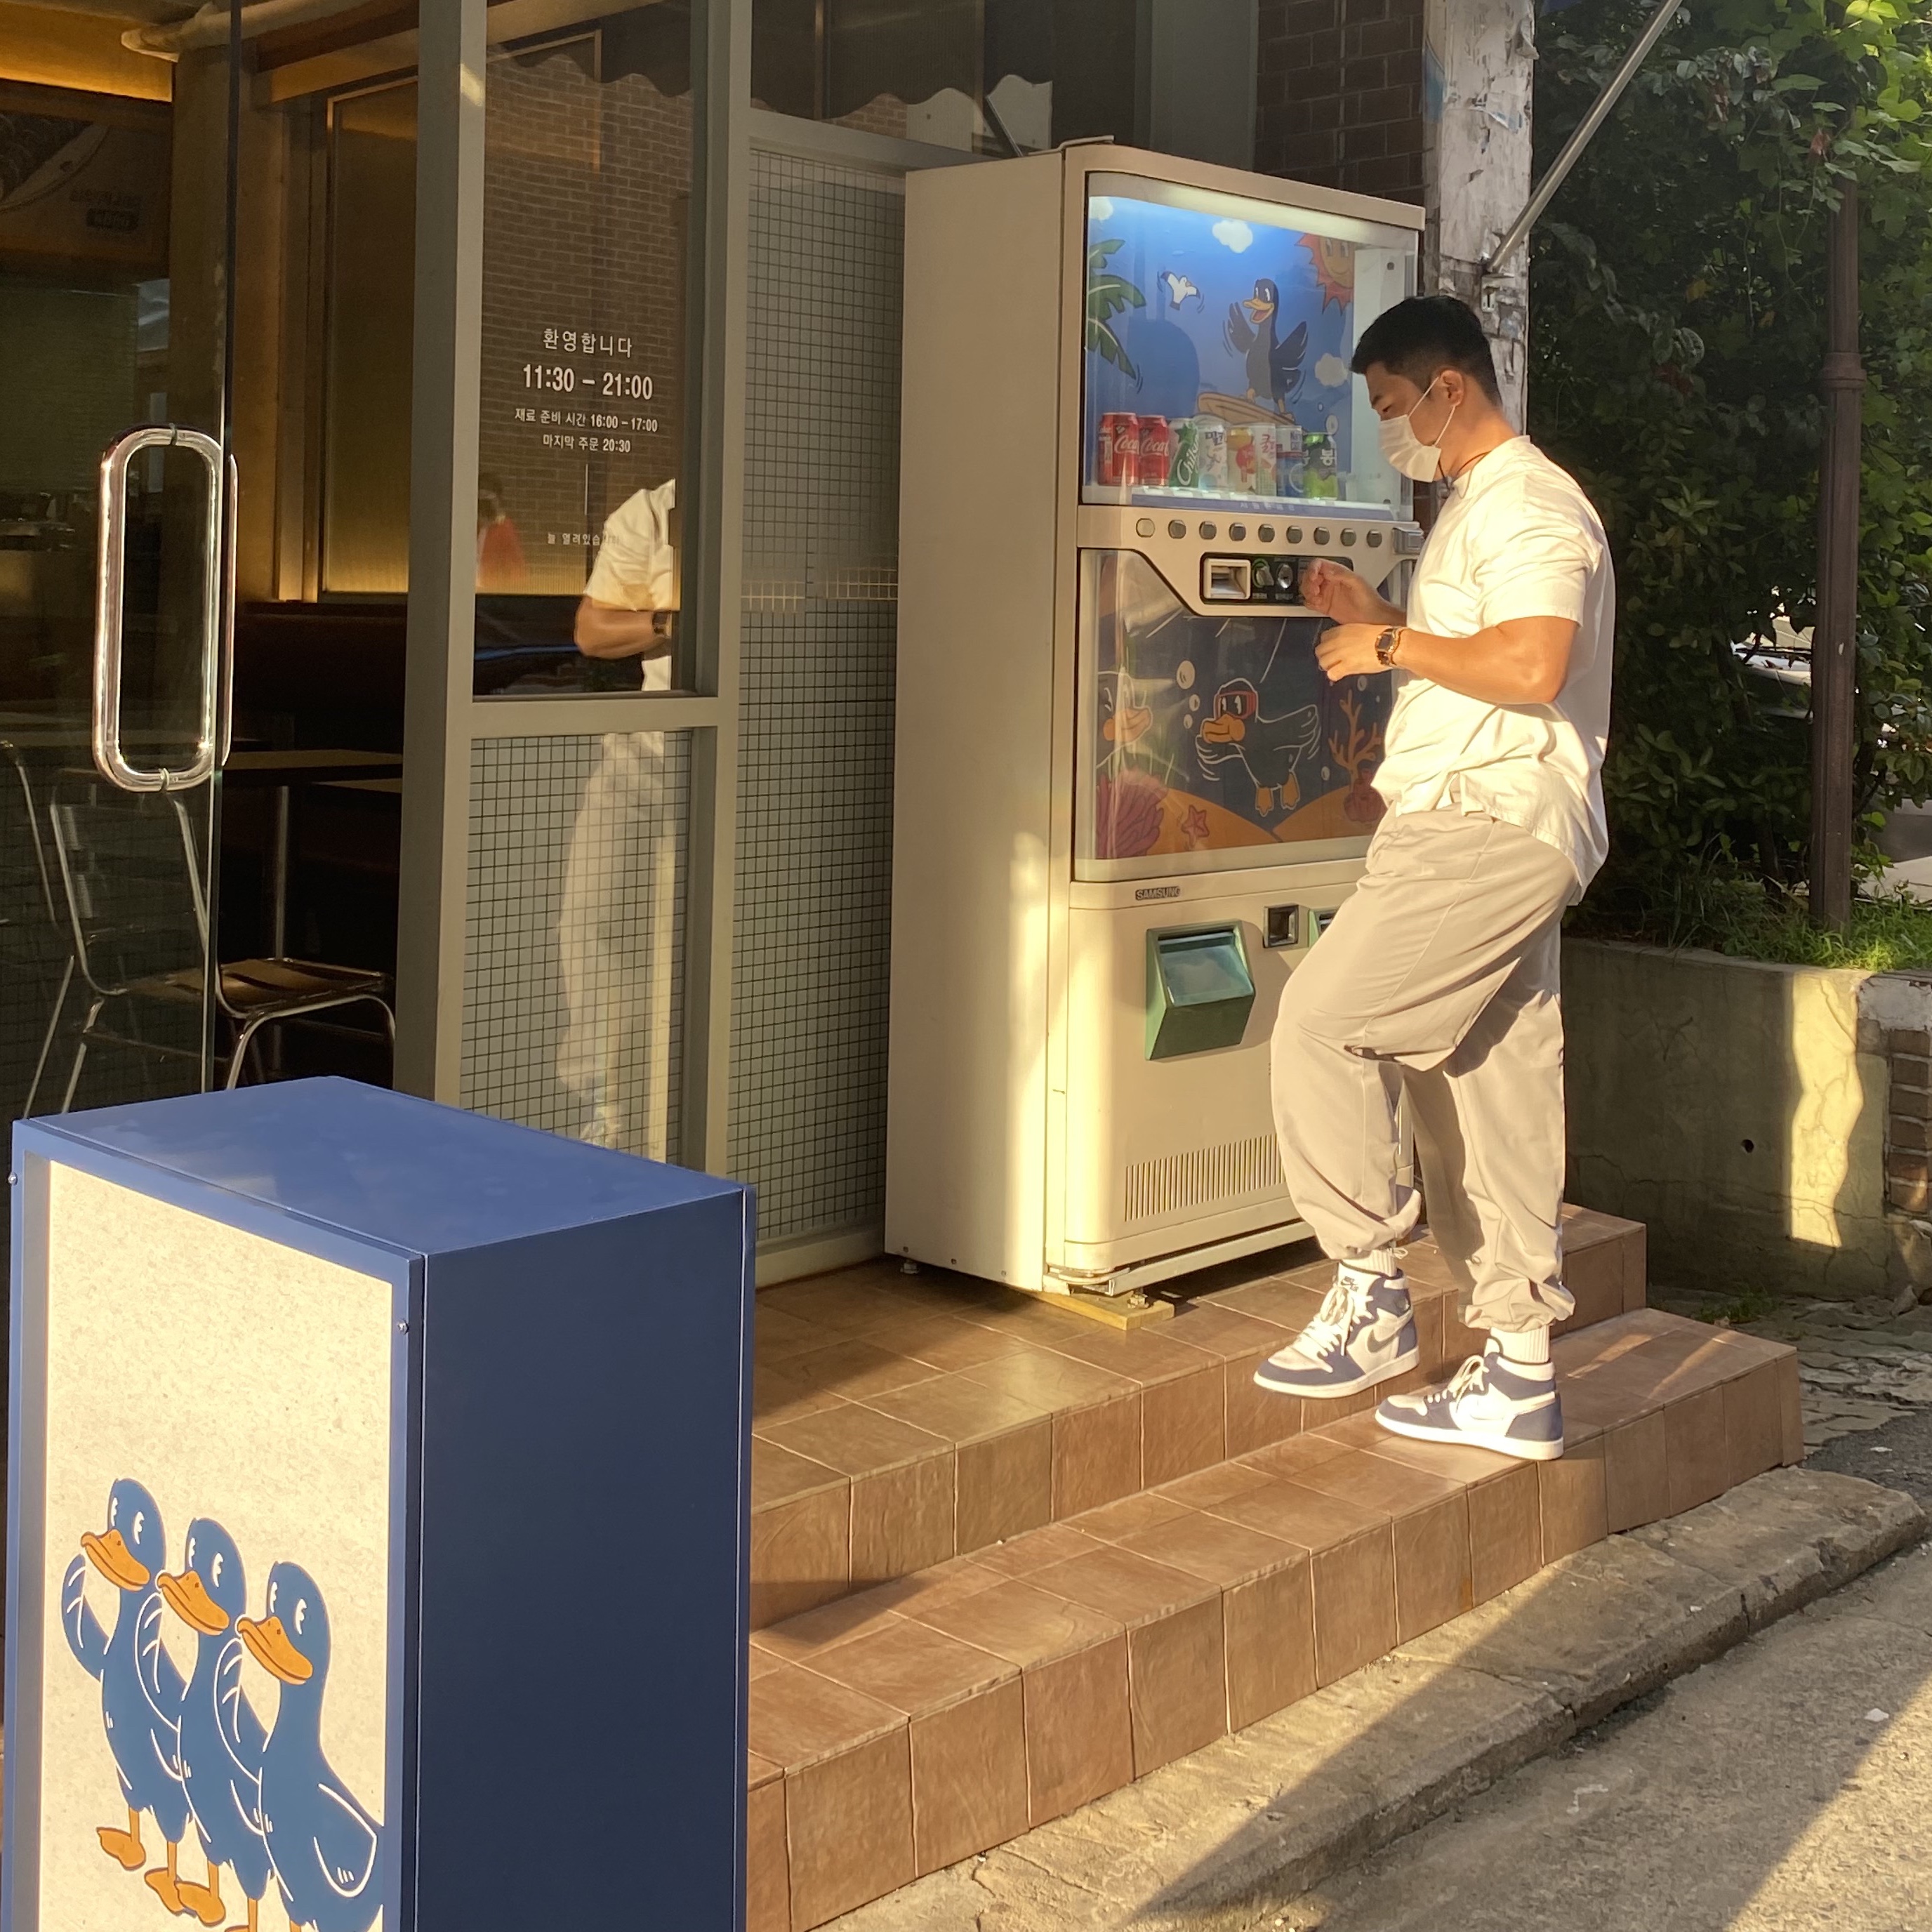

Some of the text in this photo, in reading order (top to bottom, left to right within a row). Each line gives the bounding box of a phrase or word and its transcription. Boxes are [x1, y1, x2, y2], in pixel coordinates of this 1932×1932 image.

[543, 328, 633, 359] 환영합니다
[523, 364, 575, 392] 11:30
[602, 372, 653, 400] 21:00
[515, 408, 536, 422] 재료
[540, 410, 561, 425] 준비
[565, 412, 586, 427] 시간
[590, 413, 618, 429] 16:00
[631, 417, 658, 432] 17:00
[543, 434, 630, 453] 마지막 주문 20:30
[1136, 886, 1180, 900] SAMSUNG
